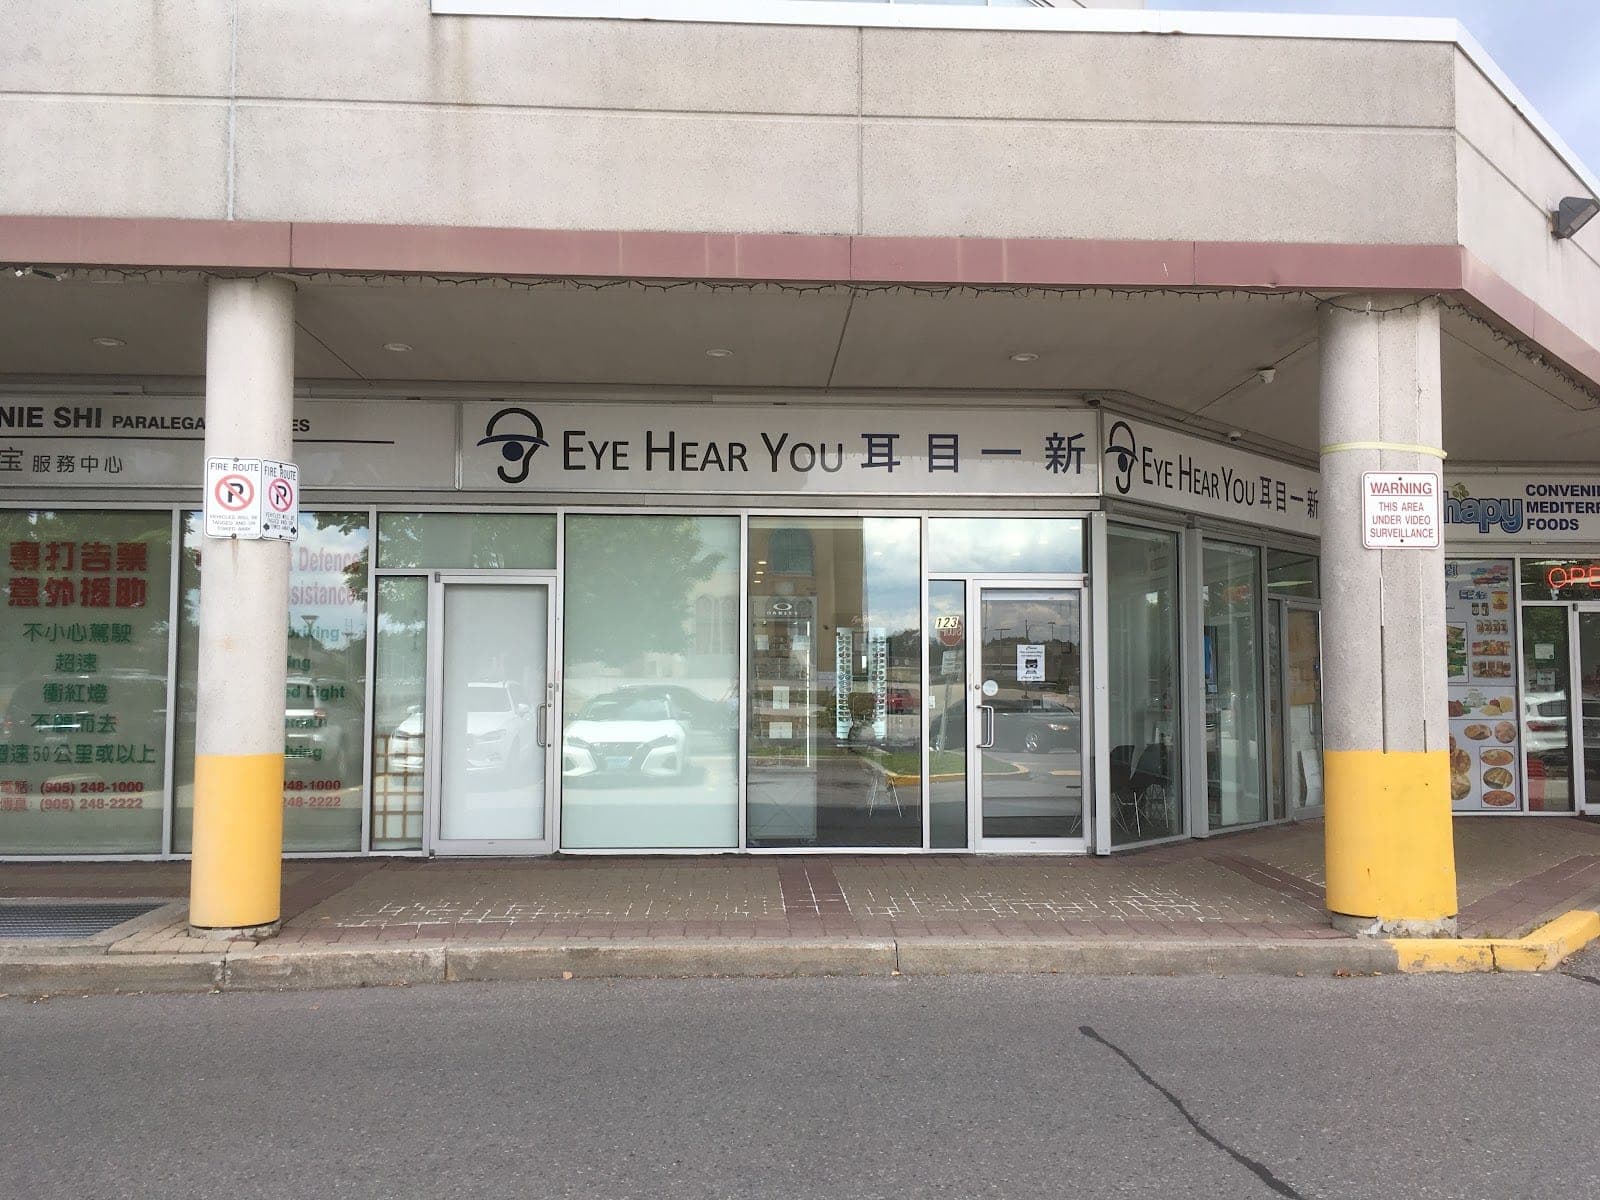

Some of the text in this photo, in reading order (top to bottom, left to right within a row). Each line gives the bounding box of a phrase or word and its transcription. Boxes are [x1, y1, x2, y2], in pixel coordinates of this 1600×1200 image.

[53, 406, 102, 429] SHI
[861, 432, 1086, 475] 耳目一新
[33, 455, 122, 474] 服務中心
[210, 462, 259, 472] FIRE ROUTE
[264, 465, 296, 481] FIRE ROUTE
[1370, 482, 1433, 494] WARNING
[1259, 475, 1319, 520] 耳目一新
[1379, 501, 1424, 512] THIS AREA
[1372, 515, 1431, 525] UNDER VIDEO
[1527, 518, 1579, 530] FOODS
[1370, 528, 1434, 538] SURVEILLANCE
[289, 580, 356, 605] sistance
[937, 617, 957, 628] 123
[54, 653, 97, 673] 超速
[40, 781, 75, 795] (905)
[80, 781, 144, 793] 248-1000
[40, 798, 74, 812] (905)
[80, 798, 143, 810] 248-2222
